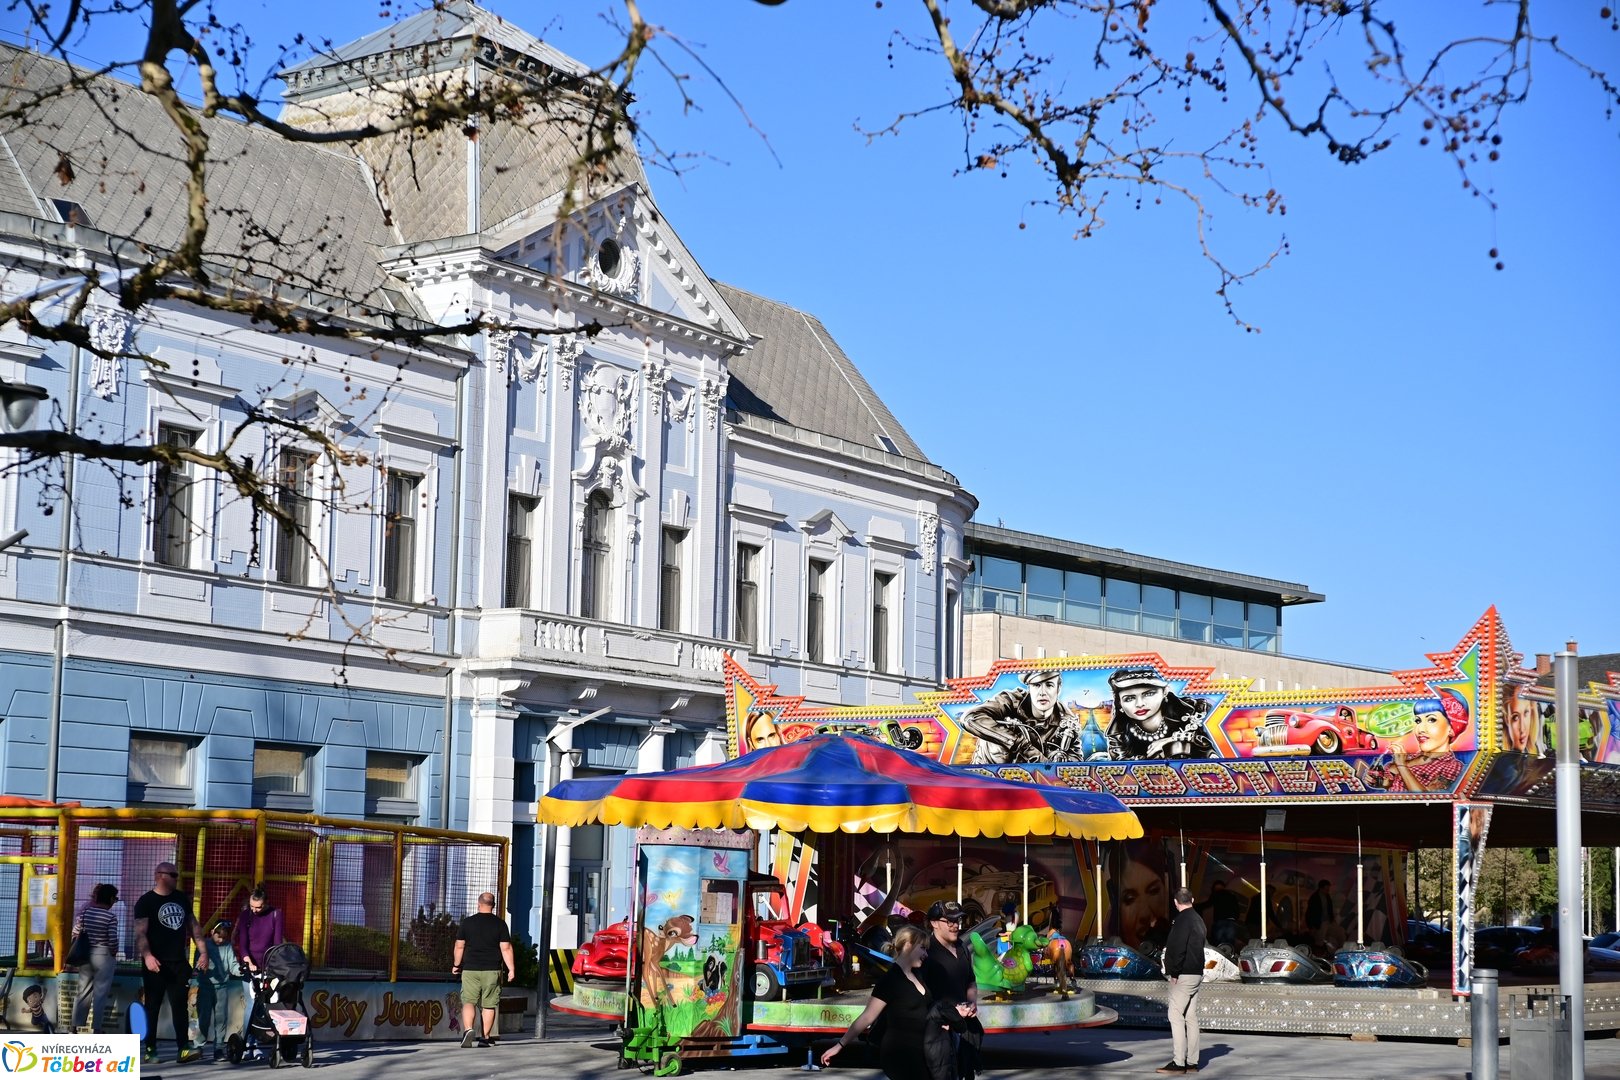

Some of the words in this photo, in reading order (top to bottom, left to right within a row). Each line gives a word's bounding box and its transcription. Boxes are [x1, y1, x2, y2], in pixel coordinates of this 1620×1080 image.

[310, 989, 368, 1038] Sky
[373, 991, 443, 1035] Jump
[820, 1009, 852, 1022] Mese
